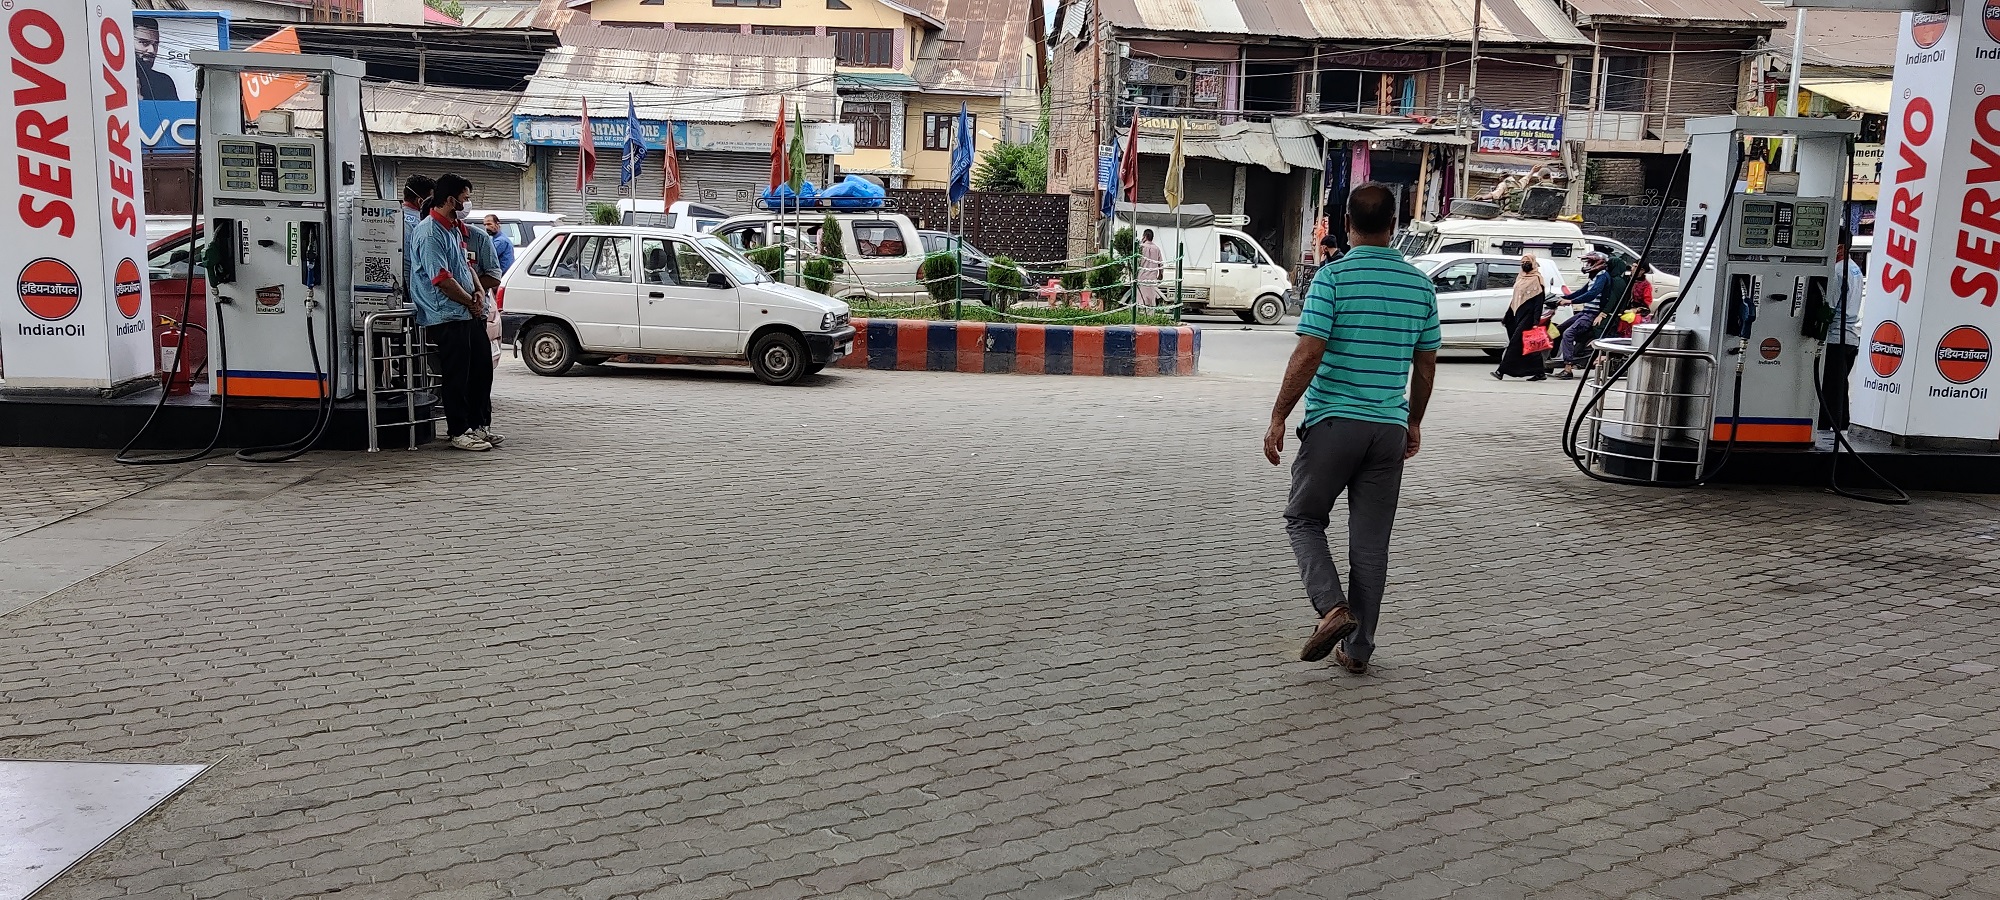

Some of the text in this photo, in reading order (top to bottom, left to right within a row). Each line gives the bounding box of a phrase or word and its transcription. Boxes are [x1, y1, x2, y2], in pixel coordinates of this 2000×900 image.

[1905, 49, 1946, 66] IndianOil
[8, 8, 76, 238] SERVO
[100, 17, 136, 237] SERVO
[1488, 114, 1557, 131] Suhail
[1500, 130, 1520, 138] Beauty
[1882, 96, 1934, 304] SERVO
[1950, 94, 2000, 307] SERVO
[242, 227, 250, 258] DIESEL
[1795, 282, 1803, 310] DIESEL
[18, 323, 85, 337] IndianOil
[116, 319, 146, 337] IndianOil
[1863, 377, 1901, 395] IndianOil
[1928, 385, 1988, 399] IndianOil
